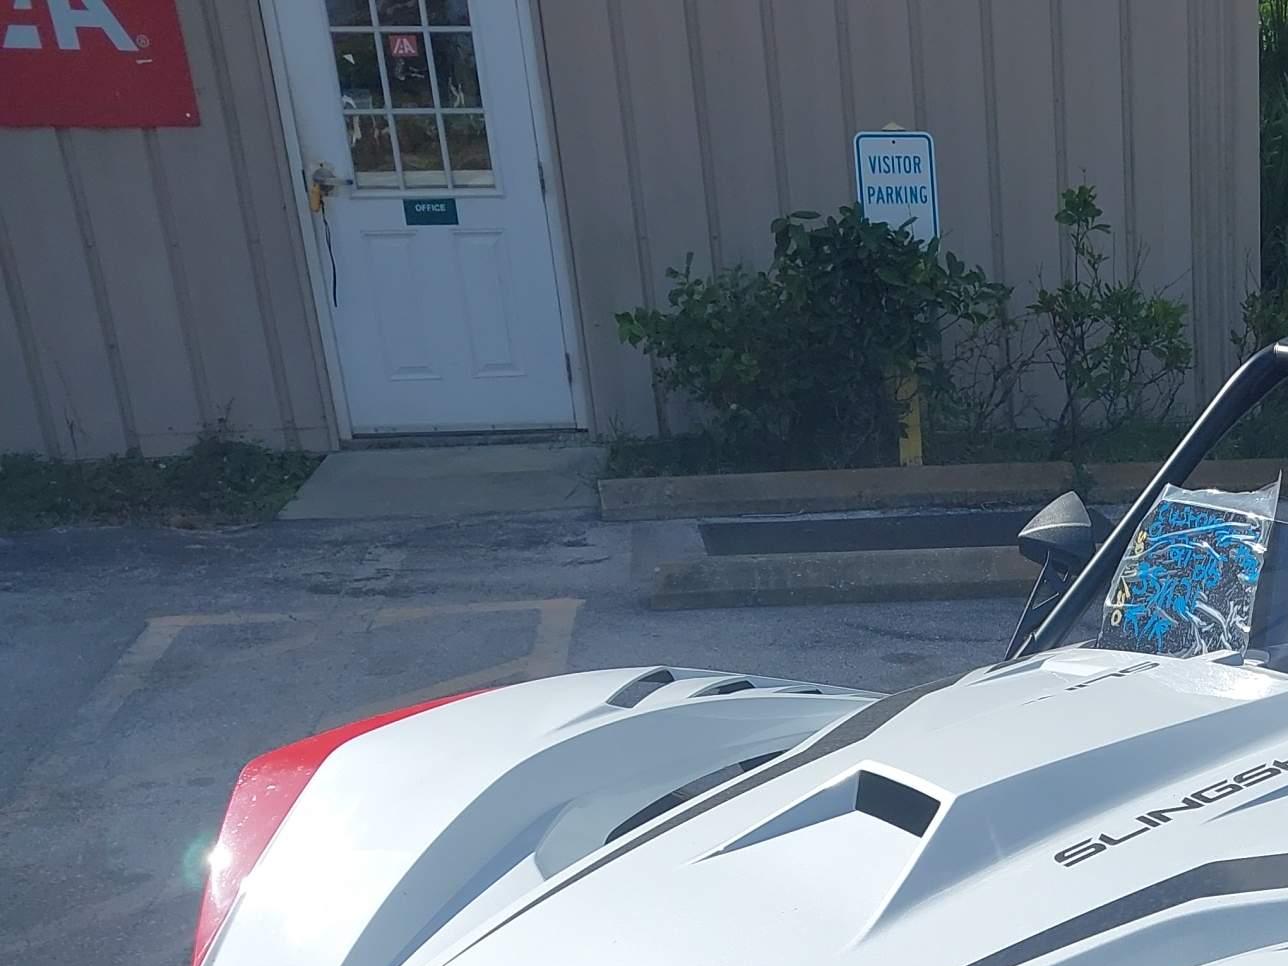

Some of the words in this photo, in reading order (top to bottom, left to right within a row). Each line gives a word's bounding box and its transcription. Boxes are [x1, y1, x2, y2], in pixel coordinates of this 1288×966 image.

[868, 155, 922, 175] VISITOR
[867, 186, 928, 205] PARKING
[414, 203, 447, 213] OFFICE
